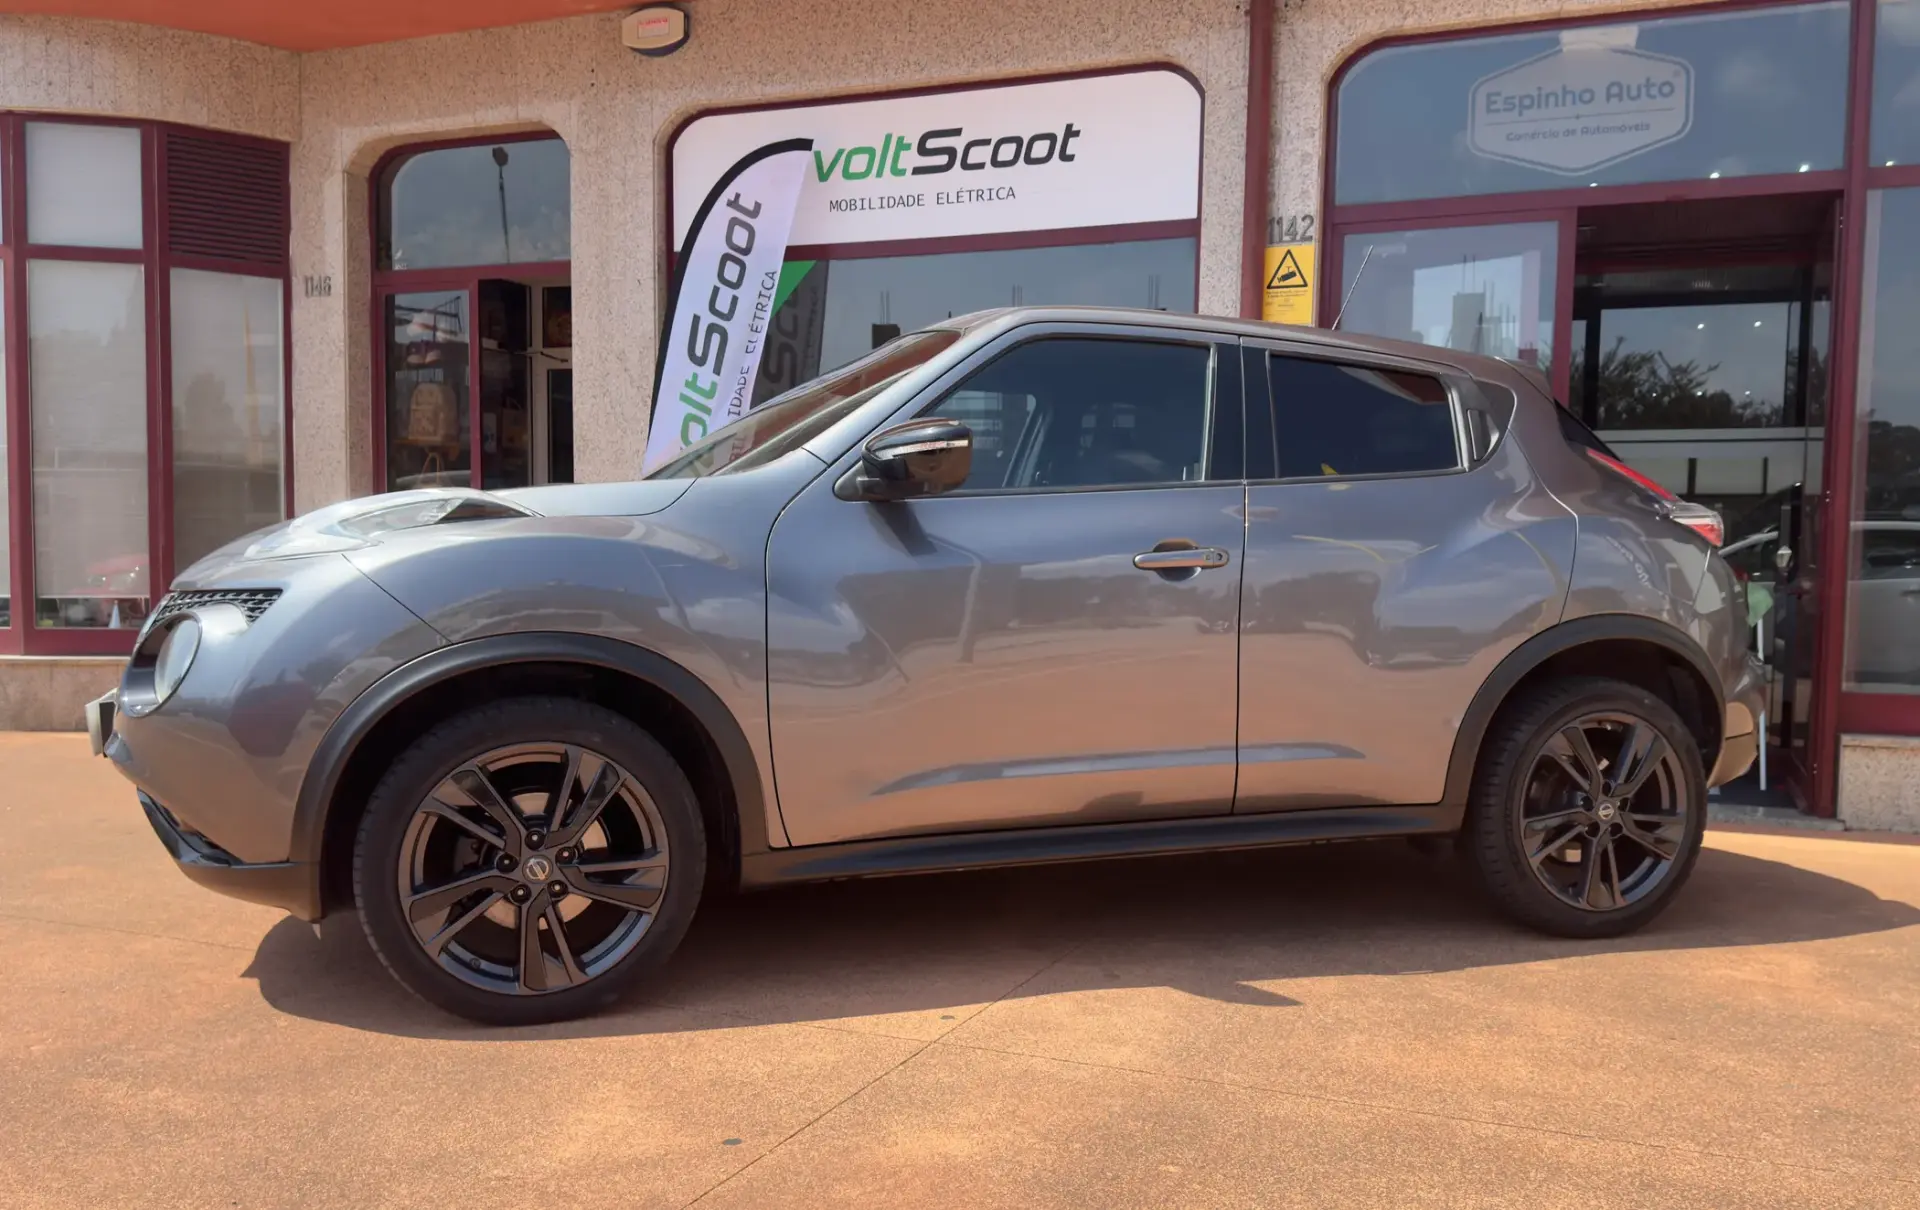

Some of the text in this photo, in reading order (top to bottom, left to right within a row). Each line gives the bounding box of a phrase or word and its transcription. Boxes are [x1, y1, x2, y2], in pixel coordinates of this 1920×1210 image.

[1485, 77, 1676, 117] Espinho Auto
[1505, 131, 1560, 142] Comércio
[1562, 129, 1577, 137] de
[813, 122, 1081, 183] voltScoot
[829, 186, 1017, 213] MOBILIDADE ELÉTRICA
[1268, 214, 1315, 244] 1142
